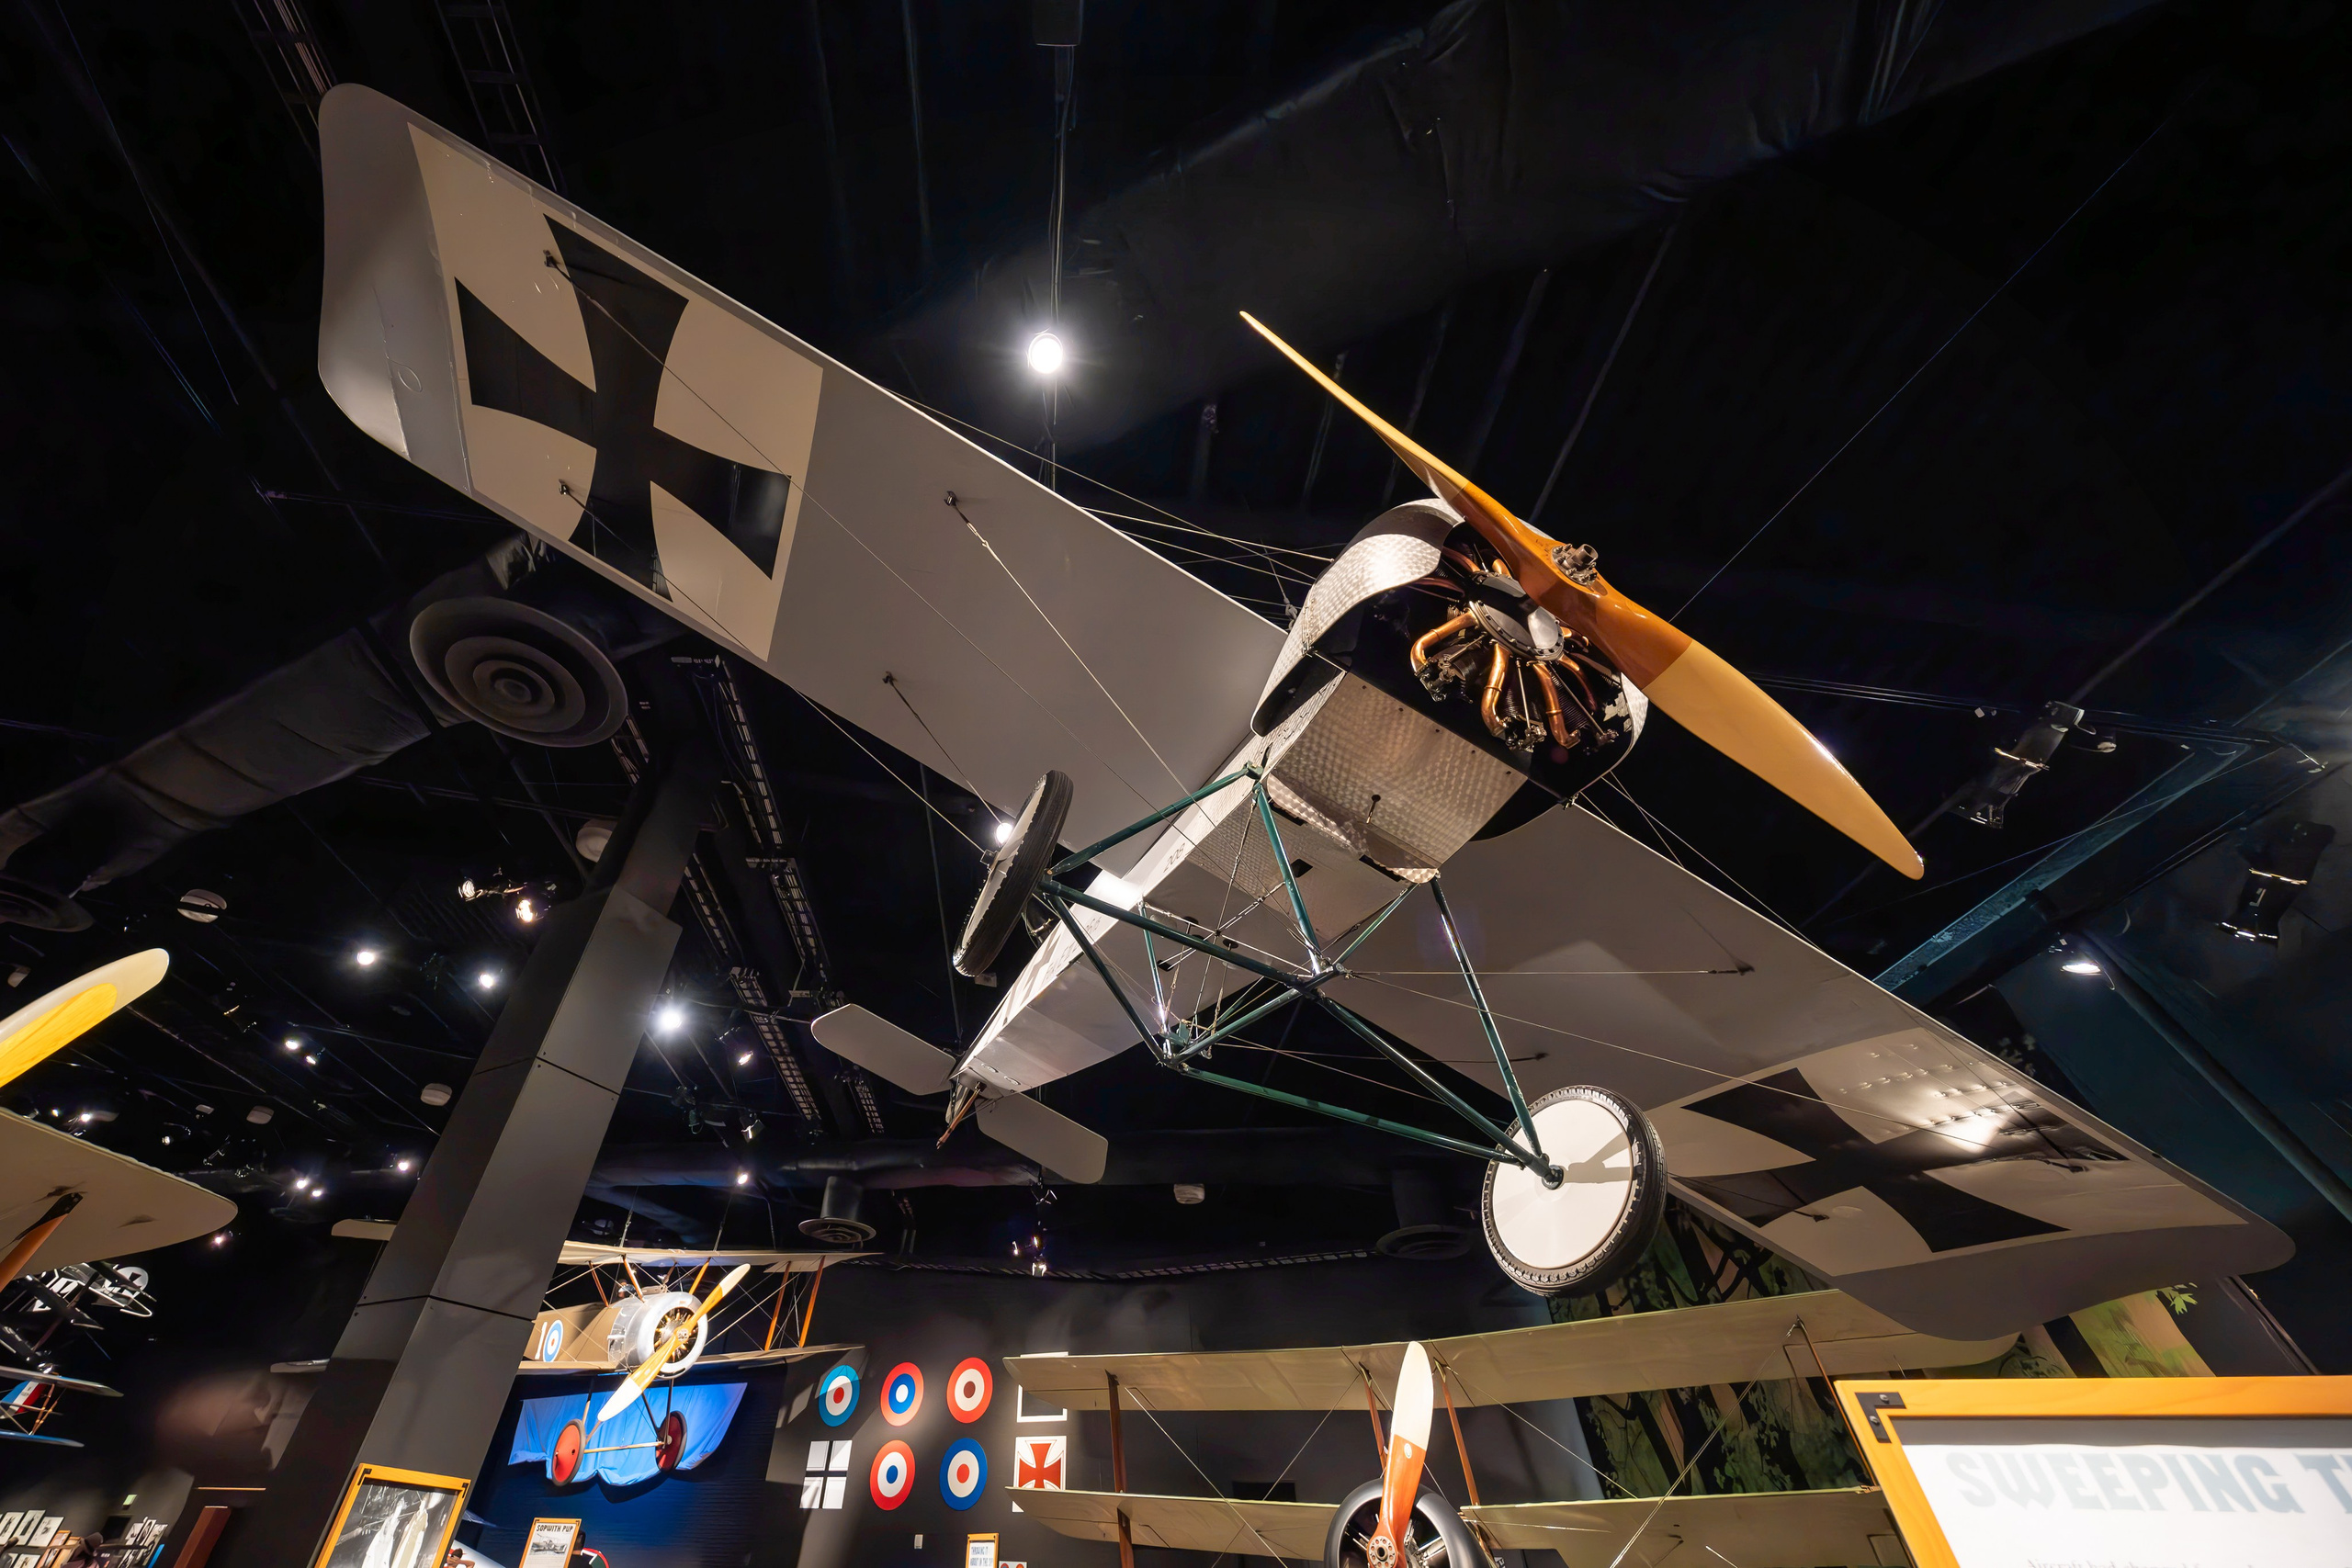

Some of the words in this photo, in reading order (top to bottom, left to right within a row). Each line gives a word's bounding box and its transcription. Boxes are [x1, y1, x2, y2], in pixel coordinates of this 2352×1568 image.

[1946, 1452, 2305, 1514] SWEEPING
[2292, 1453, 2352, 1514] T
[561, 1525, 574, 1533] PUP
